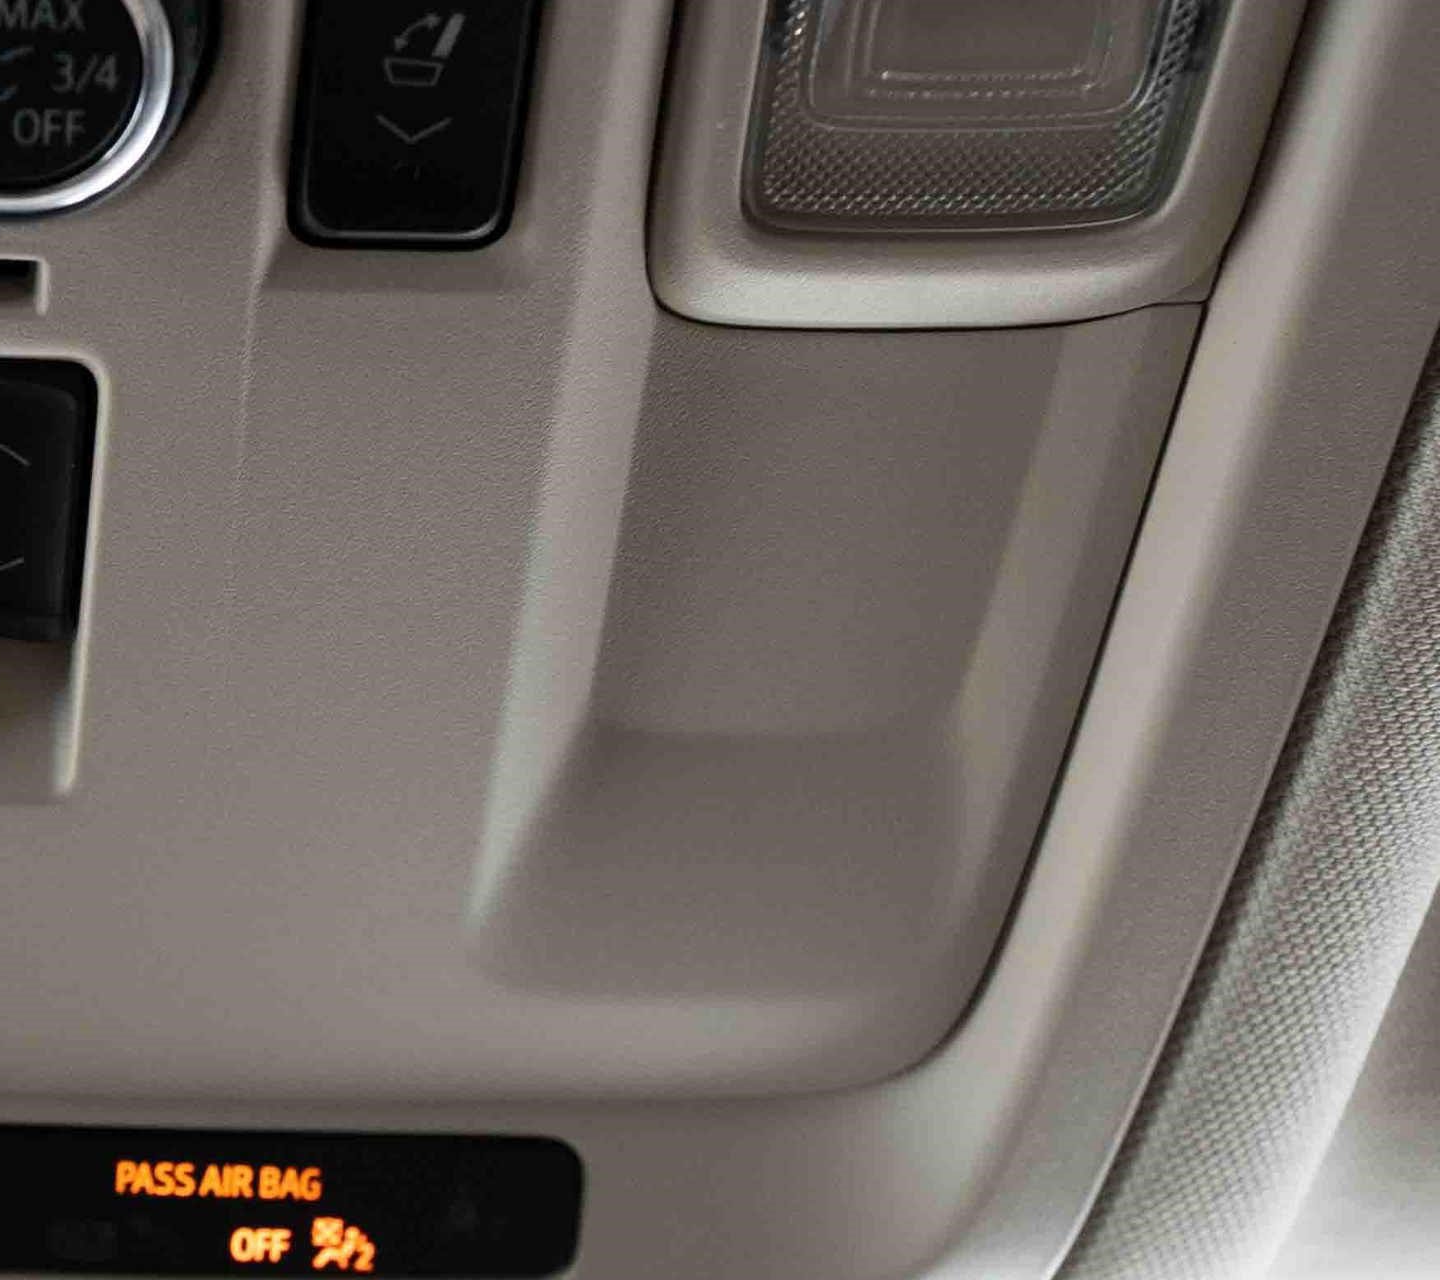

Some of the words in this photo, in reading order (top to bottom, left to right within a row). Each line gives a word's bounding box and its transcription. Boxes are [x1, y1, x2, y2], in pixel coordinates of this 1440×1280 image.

[52, 54, 118, 93] 3/4
[13, 108, 86, 146] OFF
[114, 1160, 197, 1197] PASS
[197, 1163, 254, 1198] AIR
[258, 1165, 322, 1202] BAG
[229, 1226, 292, 1264] OFF
